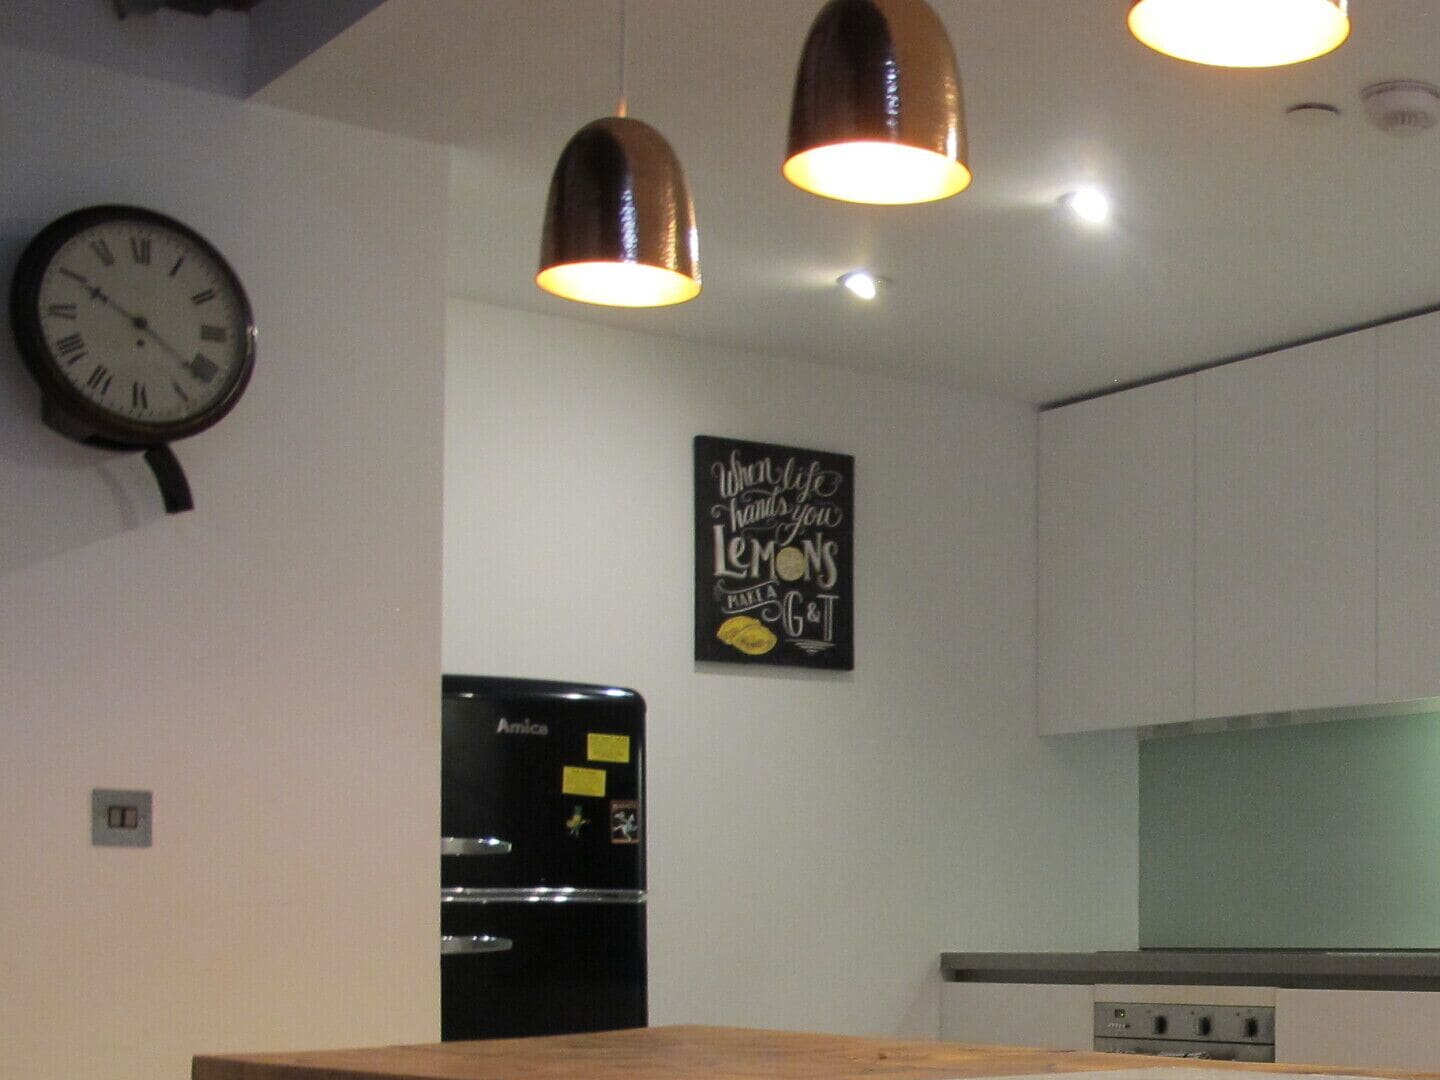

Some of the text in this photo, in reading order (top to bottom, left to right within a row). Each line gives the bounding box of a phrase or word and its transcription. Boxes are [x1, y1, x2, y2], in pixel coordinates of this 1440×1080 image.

[712, 449, 843, 502] When life
[711, 488, 843, 546] hands you
[727, 588, 777, 610] MAKE A
[782, 590, 840, 642] G&T
[496, 717, 549, 736] Amica
